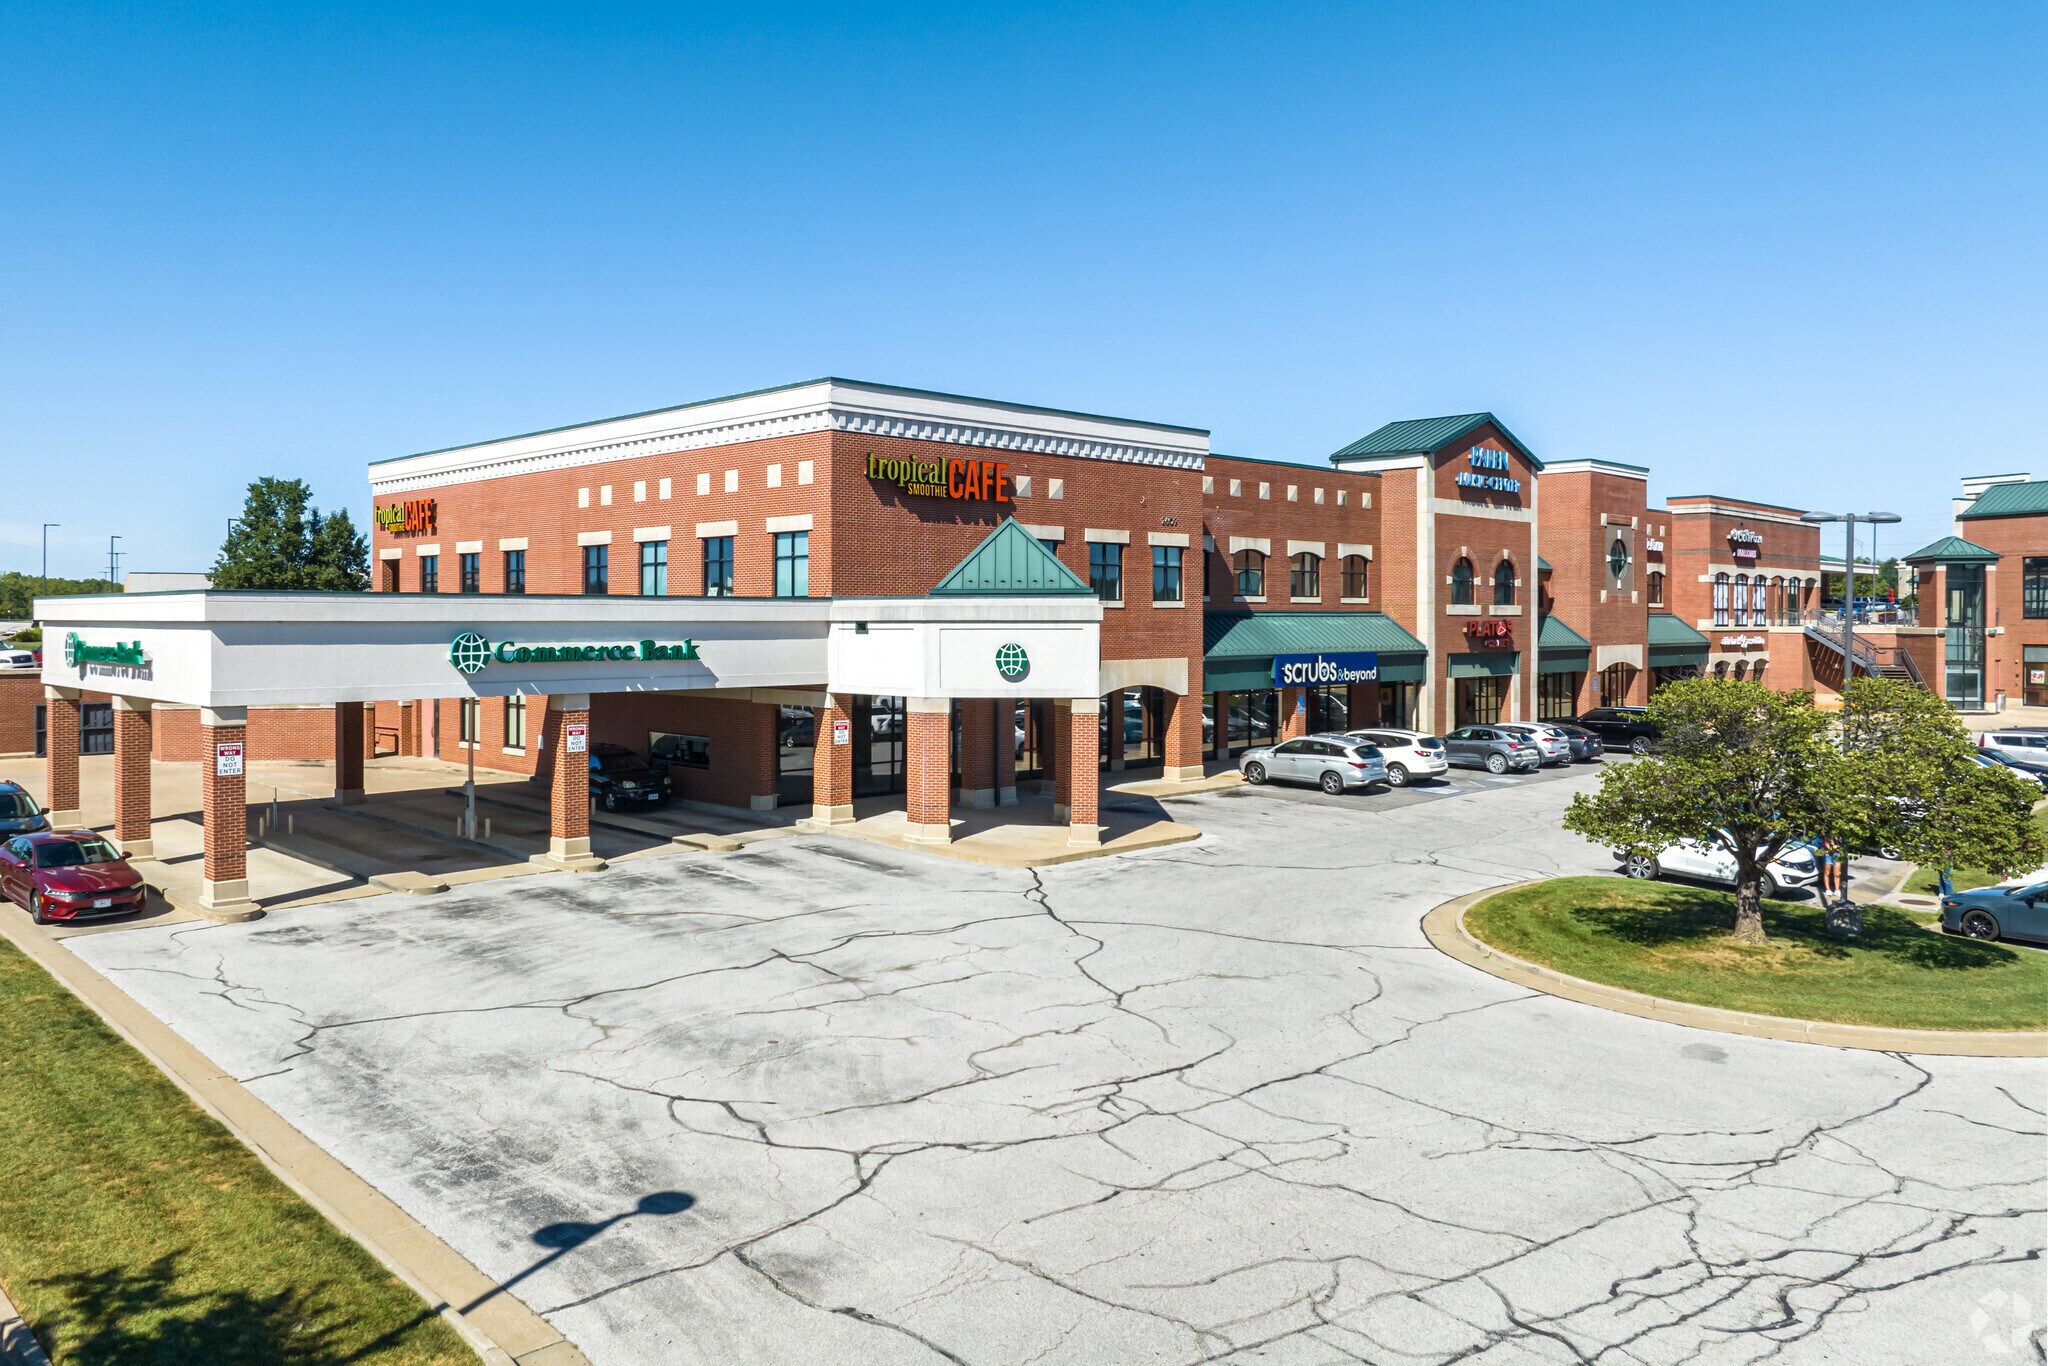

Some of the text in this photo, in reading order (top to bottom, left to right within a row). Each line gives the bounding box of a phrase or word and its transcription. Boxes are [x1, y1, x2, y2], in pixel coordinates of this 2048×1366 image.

[868, 451, 1009, 502] tropical CAFE
[908, 483, 947, 498] SMOOTHIE
[374, 500, 432, 531] tropical CAFE
[494, 638, 701, 663] Commerce Bank
[1284, 655, 1337, 684] scrubs
